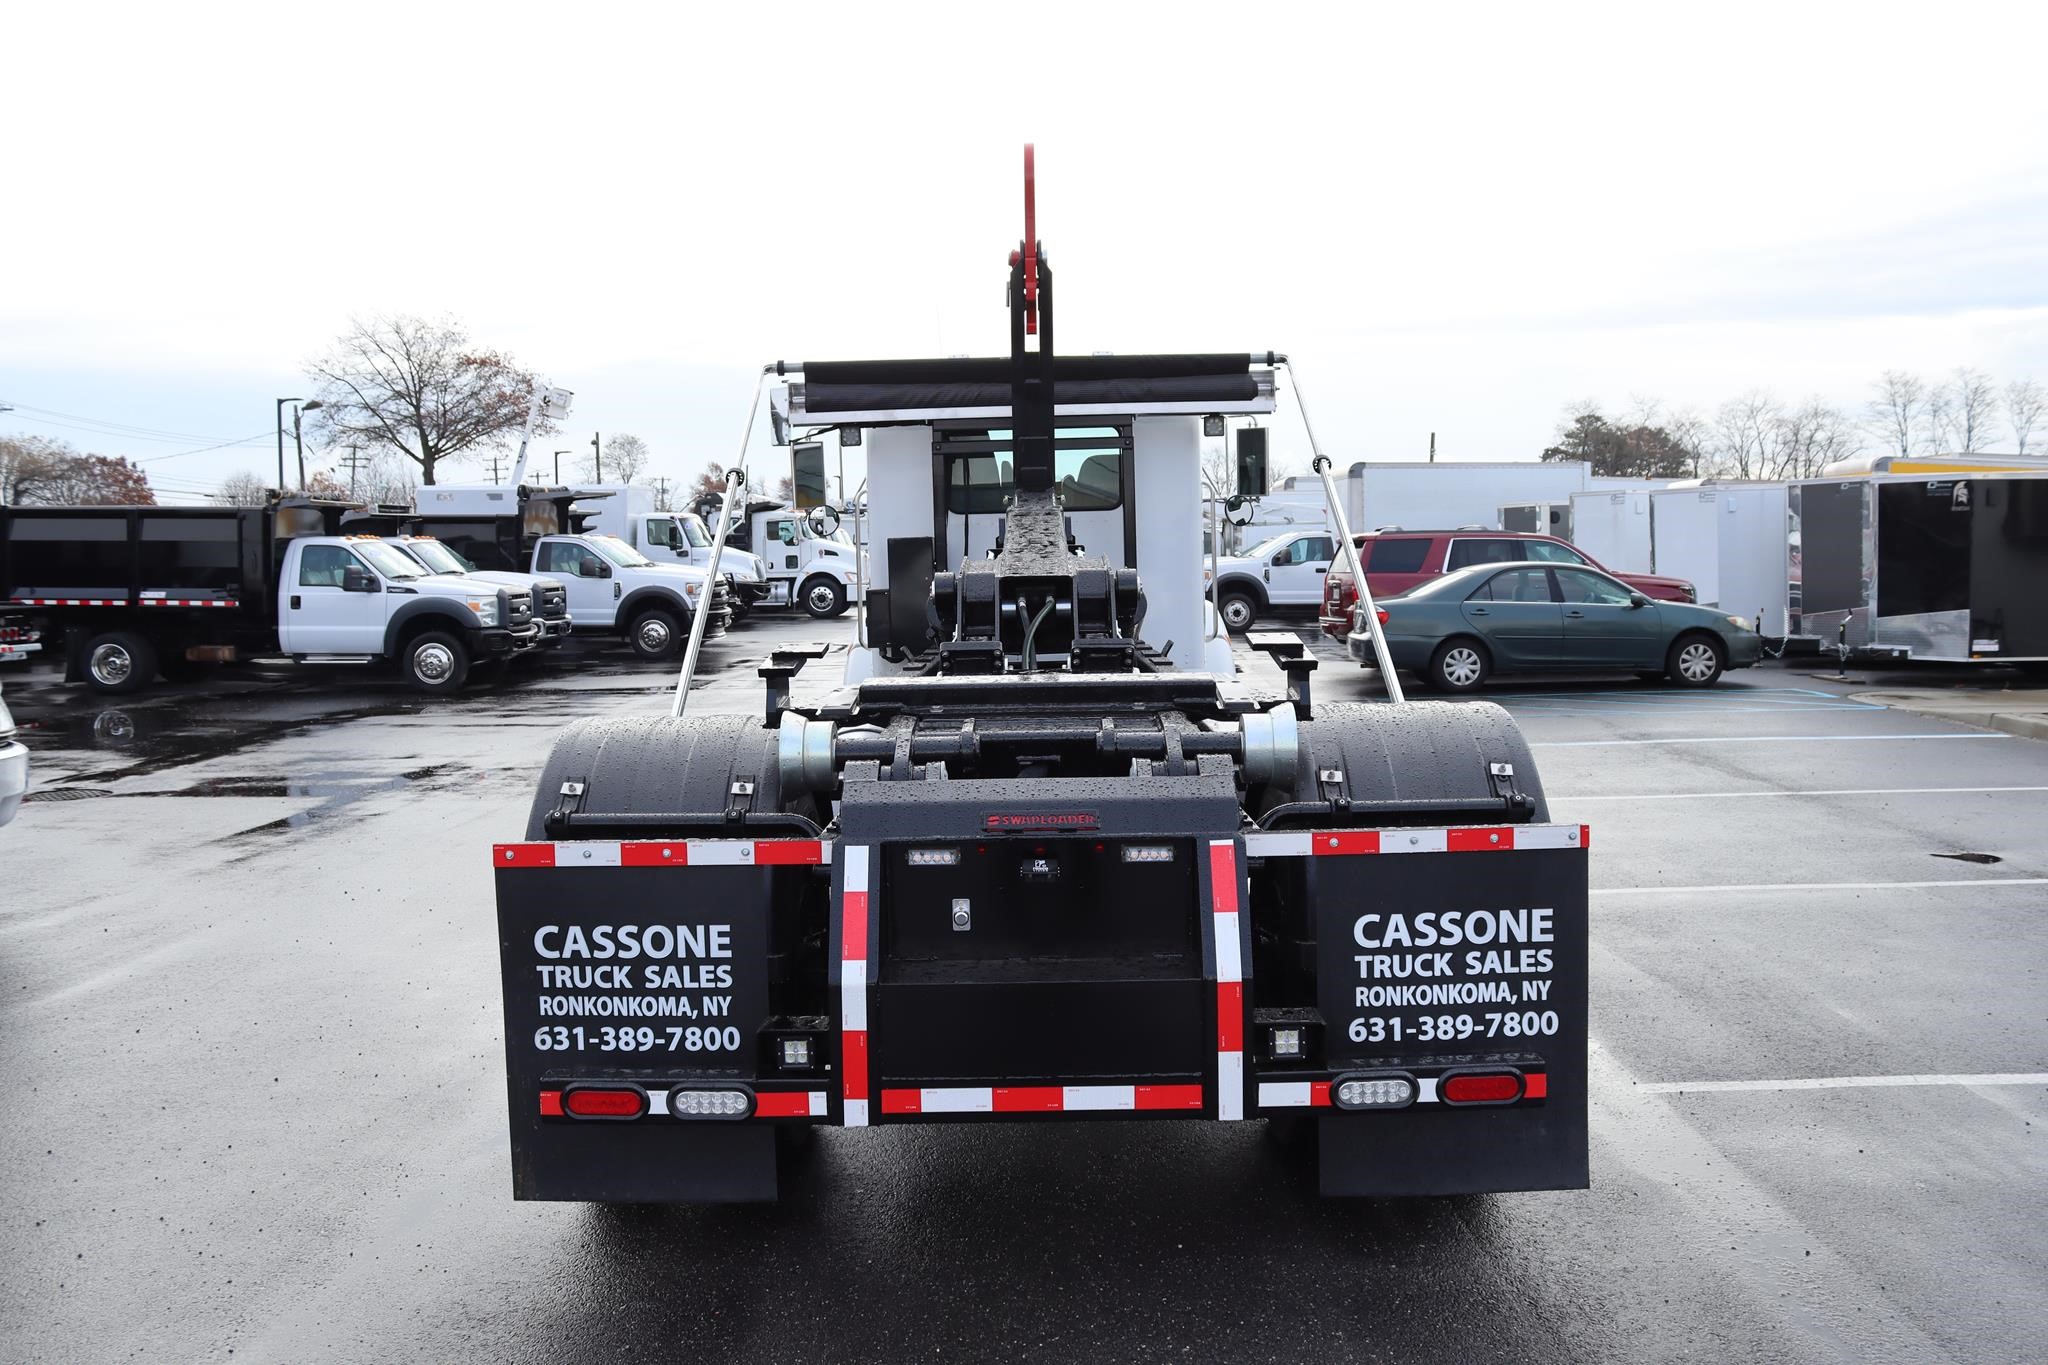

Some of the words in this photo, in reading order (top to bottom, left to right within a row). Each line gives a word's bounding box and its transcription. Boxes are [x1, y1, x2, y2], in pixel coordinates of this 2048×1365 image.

[1002, 814, 1096, 825] SWAPLOADER
[533, 924, 733, 959] CASSONE
[1353, 908, 1555, 949] CASSONE
[536, 965, 633, 989] TRUCK
[644, 964, 733, 989] SALES
[1354, 952, 1454, 979] TRUCK
[1465, 948, 1554, 976] SALES
[1355, 981, 1518, 1007] RONKONKOMA,
[1522, 979, 1553, 1002] NY
[539, 995, 699, 1020] RONKONKOMA,
[702, 995, 733, 1017] NY
[534, 1026, 741, 1052] 631-389-7800
[1348, 1010, 1559, 1043] 631-389-7800
